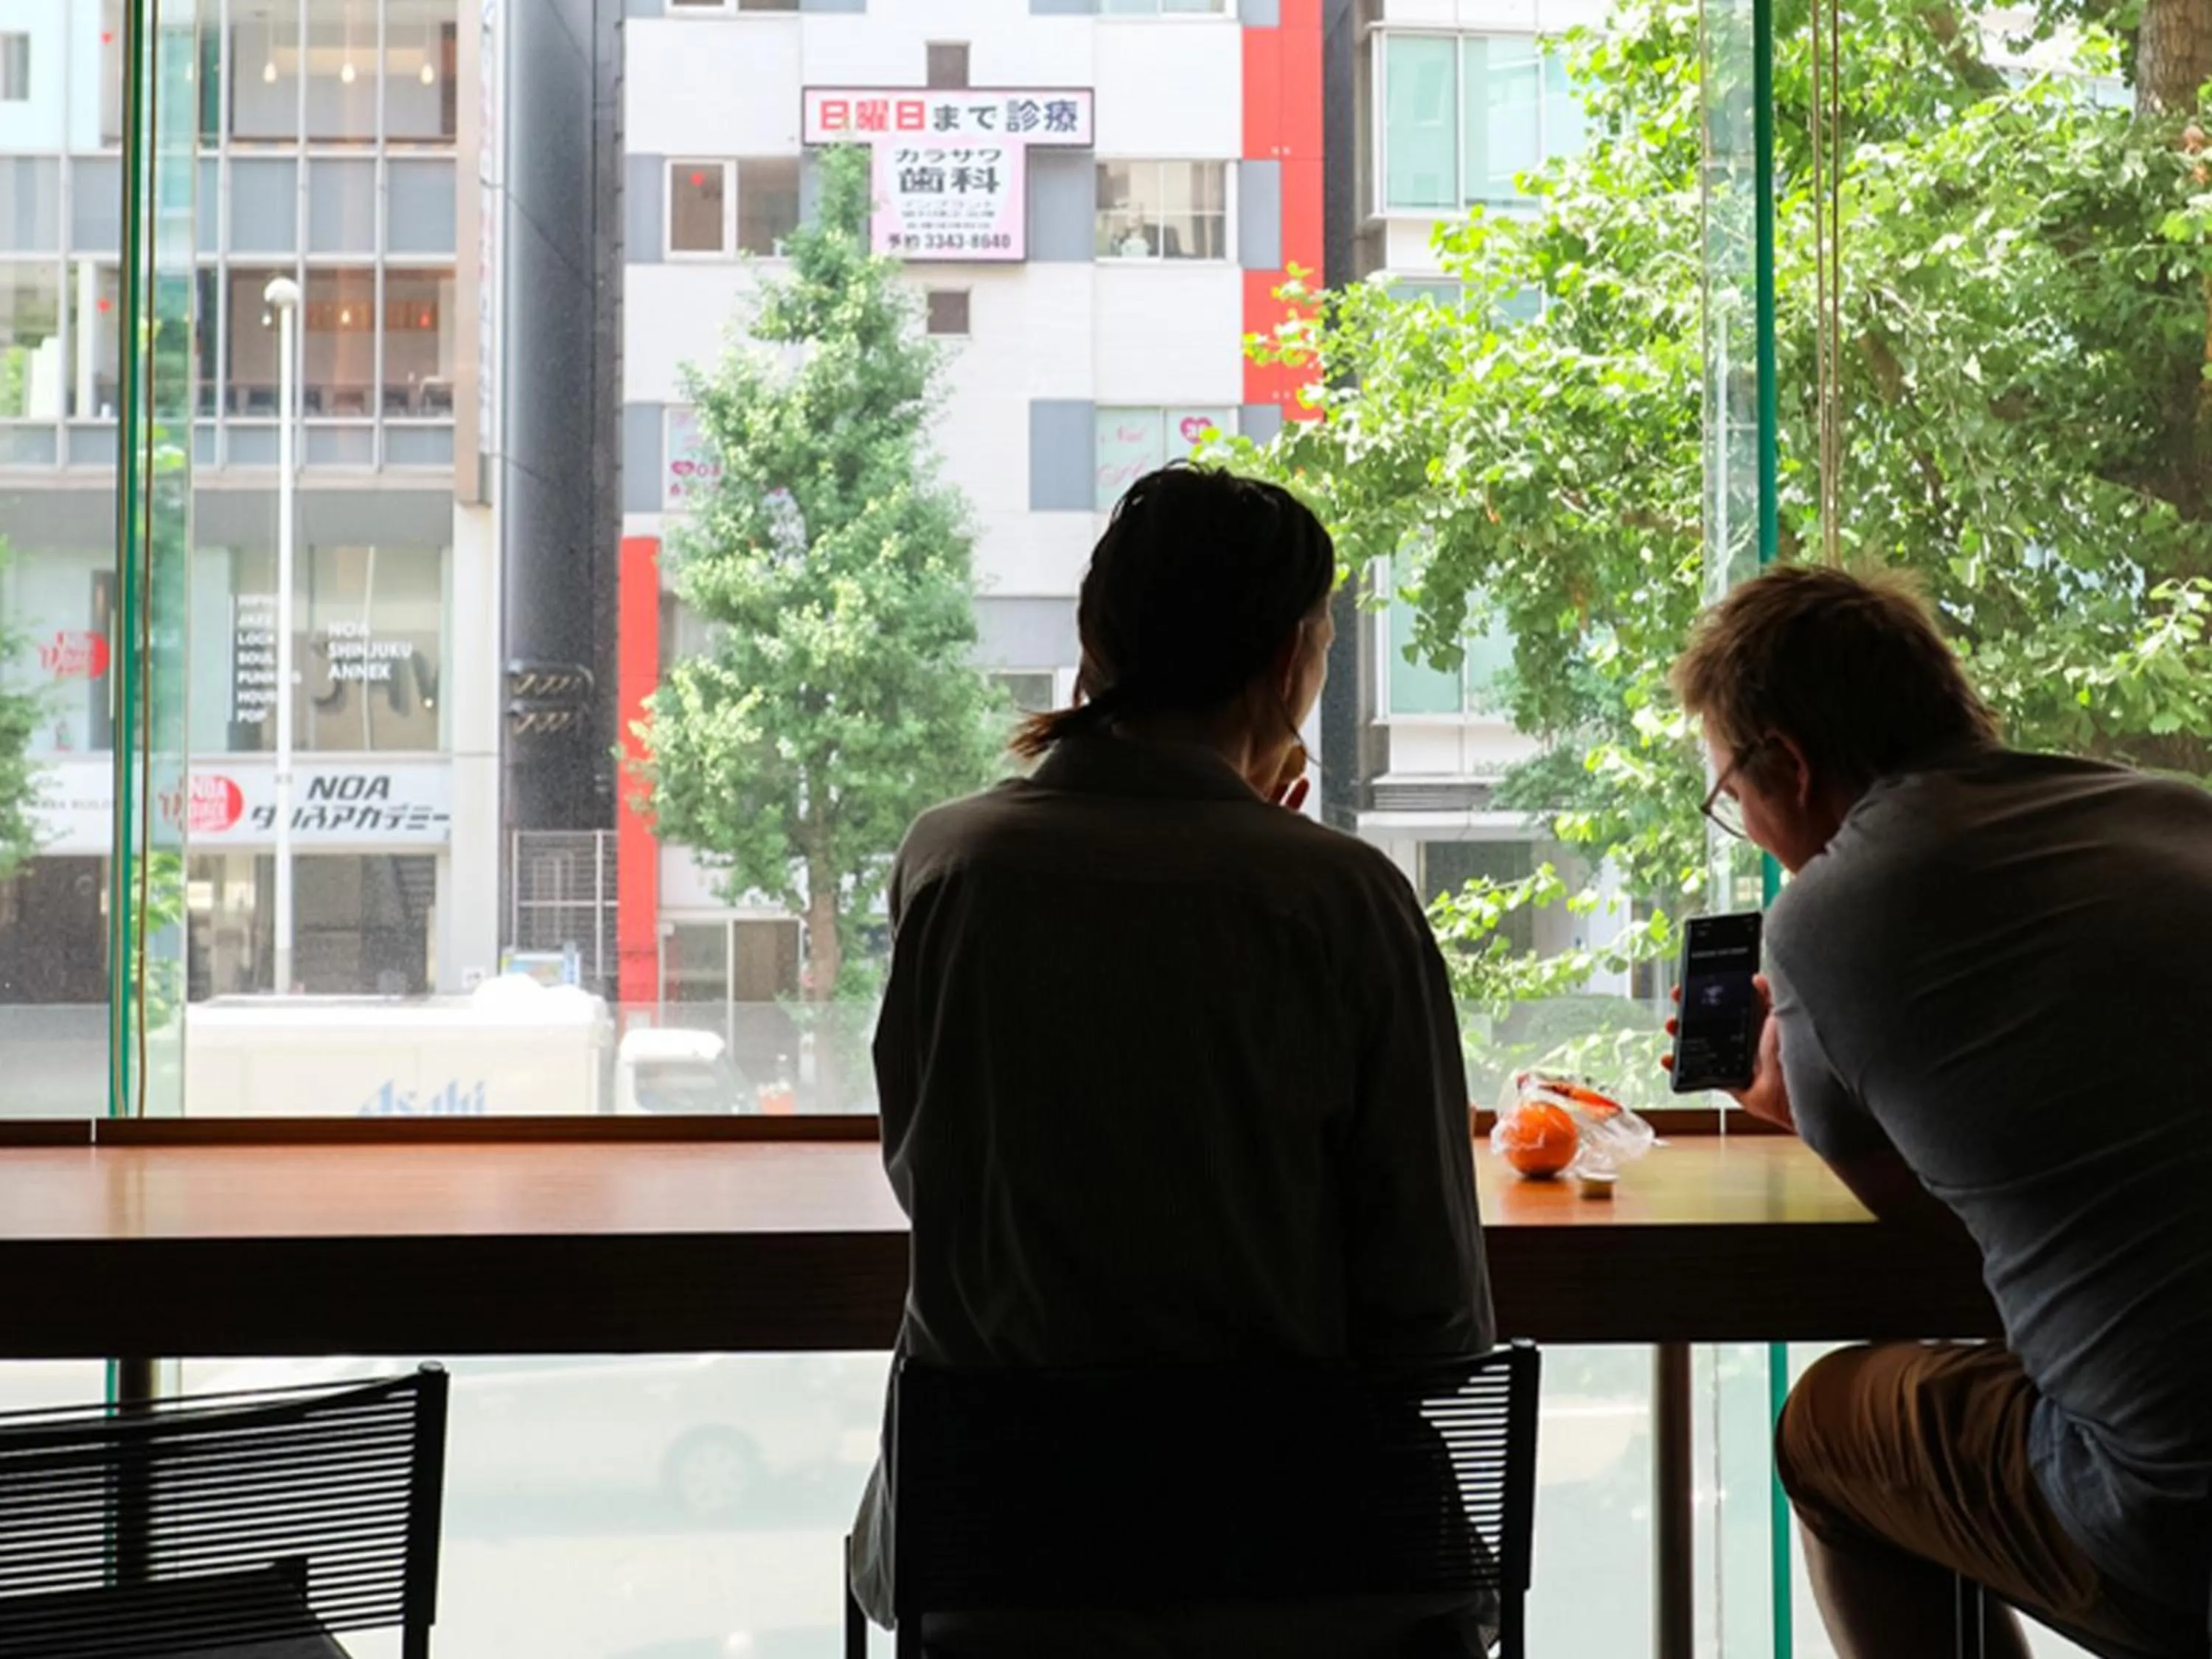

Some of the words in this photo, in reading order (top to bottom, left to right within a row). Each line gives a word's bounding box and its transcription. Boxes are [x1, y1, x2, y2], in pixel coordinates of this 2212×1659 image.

[820, 100, 1078, 133] 日曜日まで診療
[894, 148, 1002, 164] カラサワ
[898, 167, 1000, 194] 歯科
[328, 621, 369, 638] NOA
[328, 641, 413, 659] SHINJUKU
[328, 664, 392, 681] ANNEX
[307, 776, 392, 801] NOA
